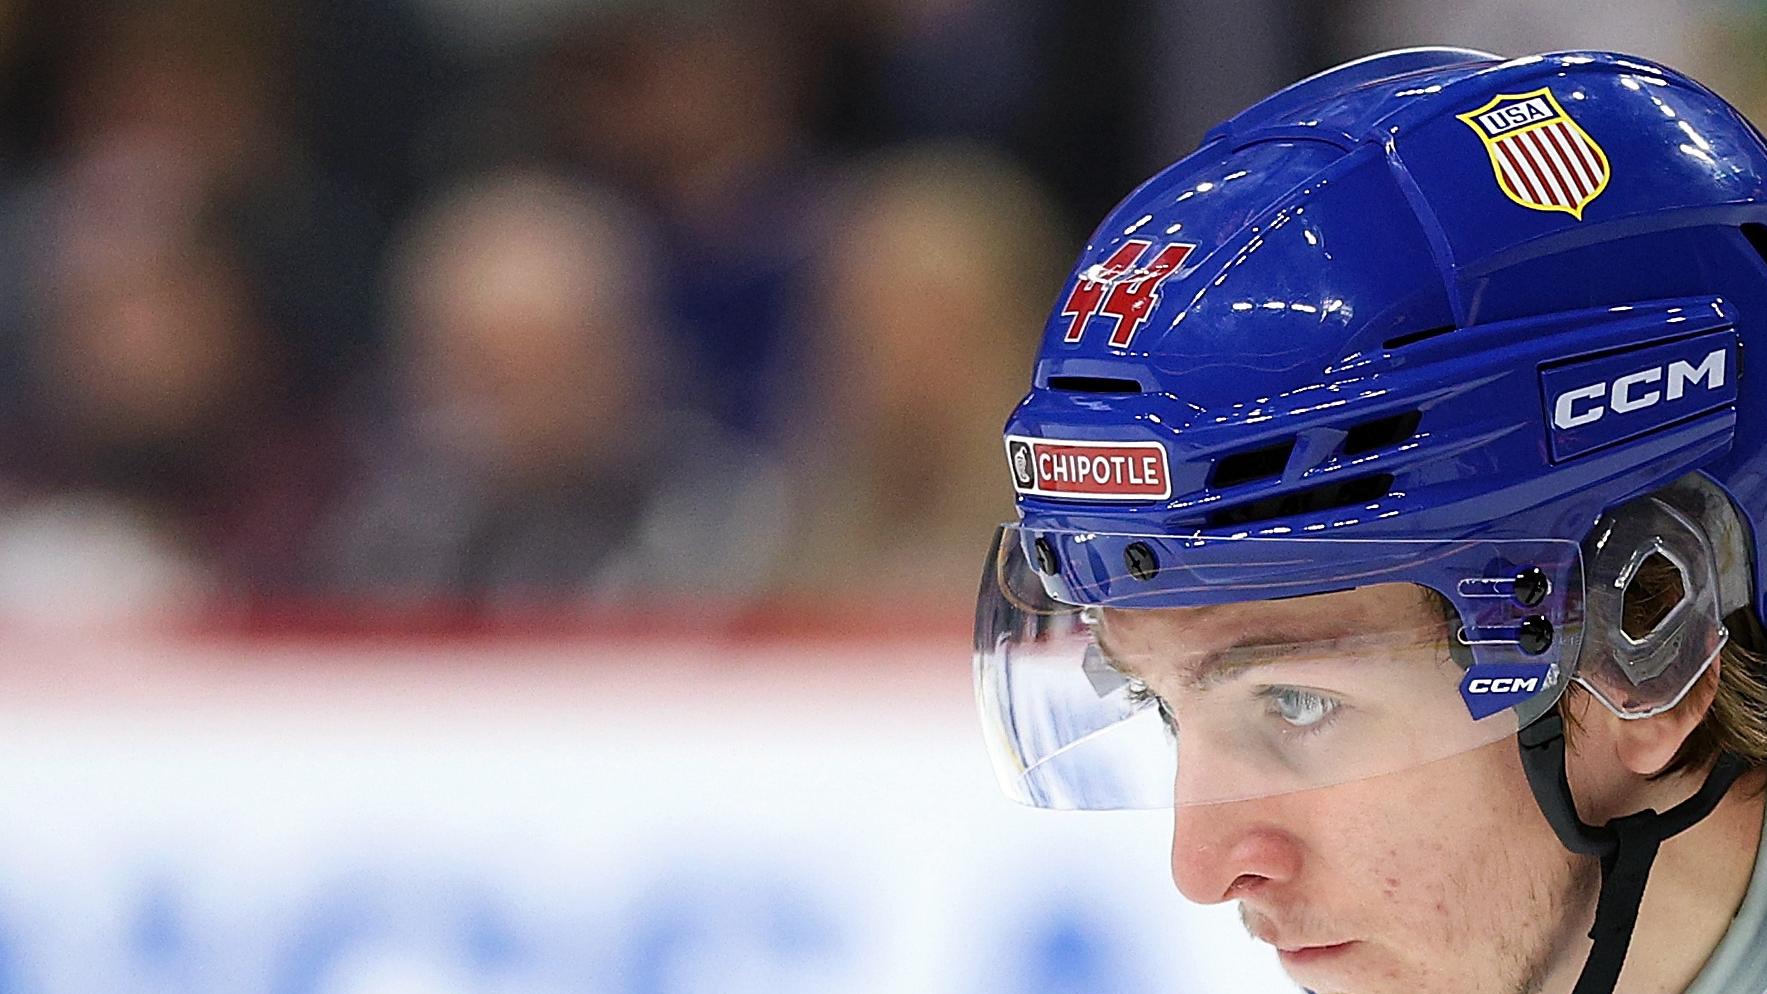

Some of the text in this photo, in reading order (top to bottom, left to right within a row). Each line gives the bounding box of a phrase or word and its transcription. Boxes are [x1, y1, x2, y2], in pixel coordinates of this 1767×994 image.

[1487, 102, 1546, 130] USA
[1061, 239, 1197, 349] 44
[1553, 348, 1727, 432] CCM
[1038, 452, 1160, 485] CHIPOTLE
[1468, 677, 1539, 694] CCM
